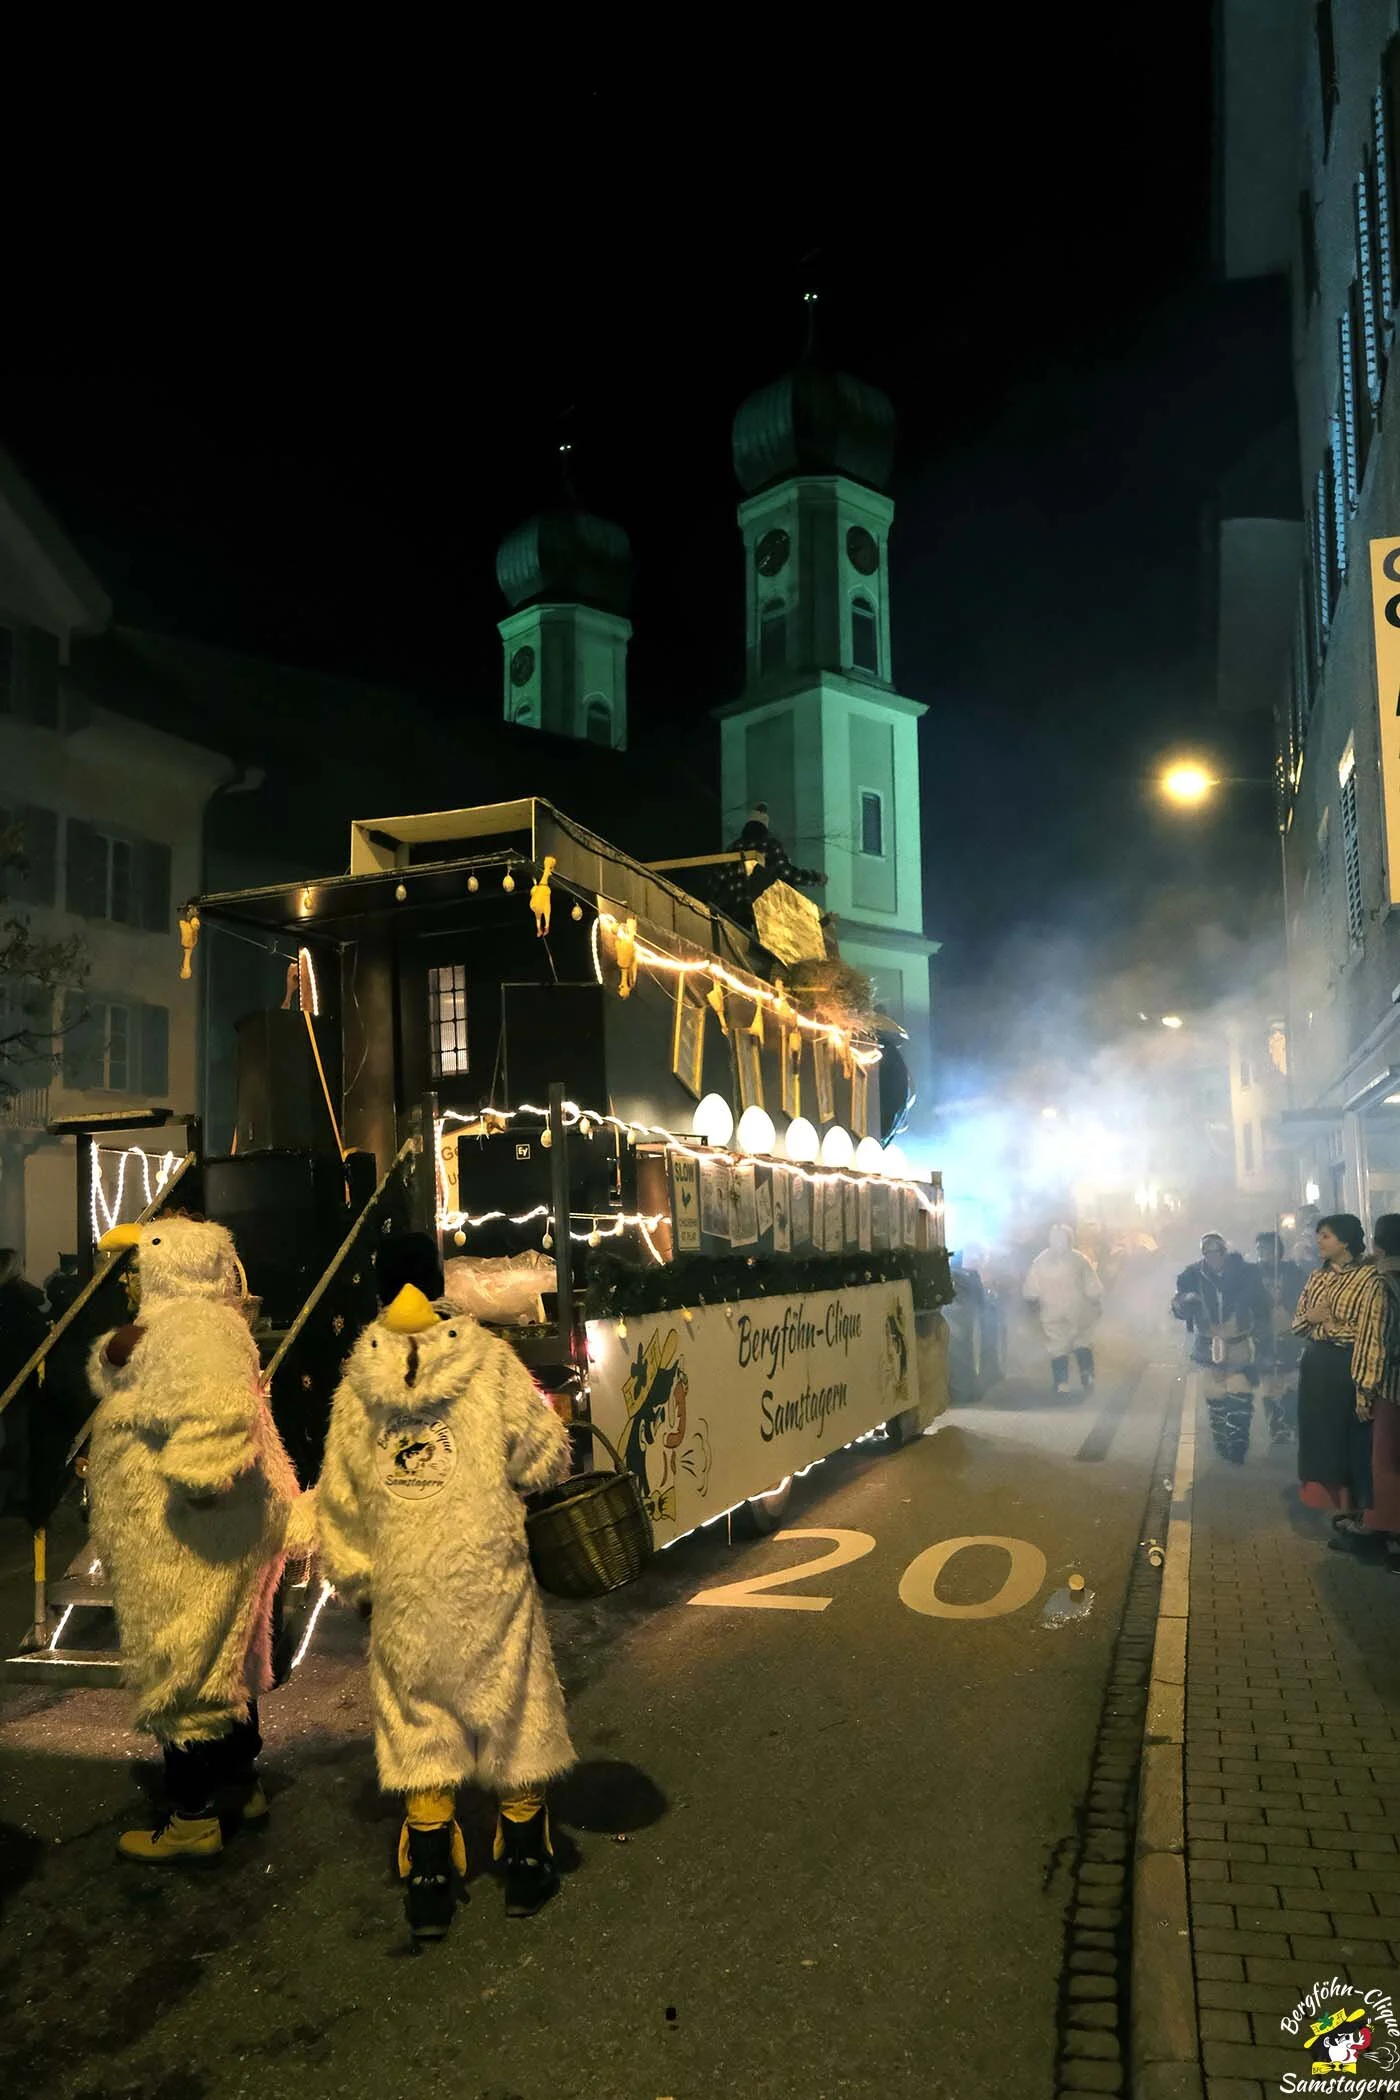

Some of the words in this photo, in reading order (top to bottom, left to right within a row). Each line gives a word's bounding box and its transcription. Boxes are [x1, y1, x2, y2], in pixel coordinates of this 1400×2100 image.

[738, 1300, 862, 1380] Bergföhn-Clique
[760, 1382, 847, 1442] Samstagern
[689, 1528, 1047, 1619] 20
